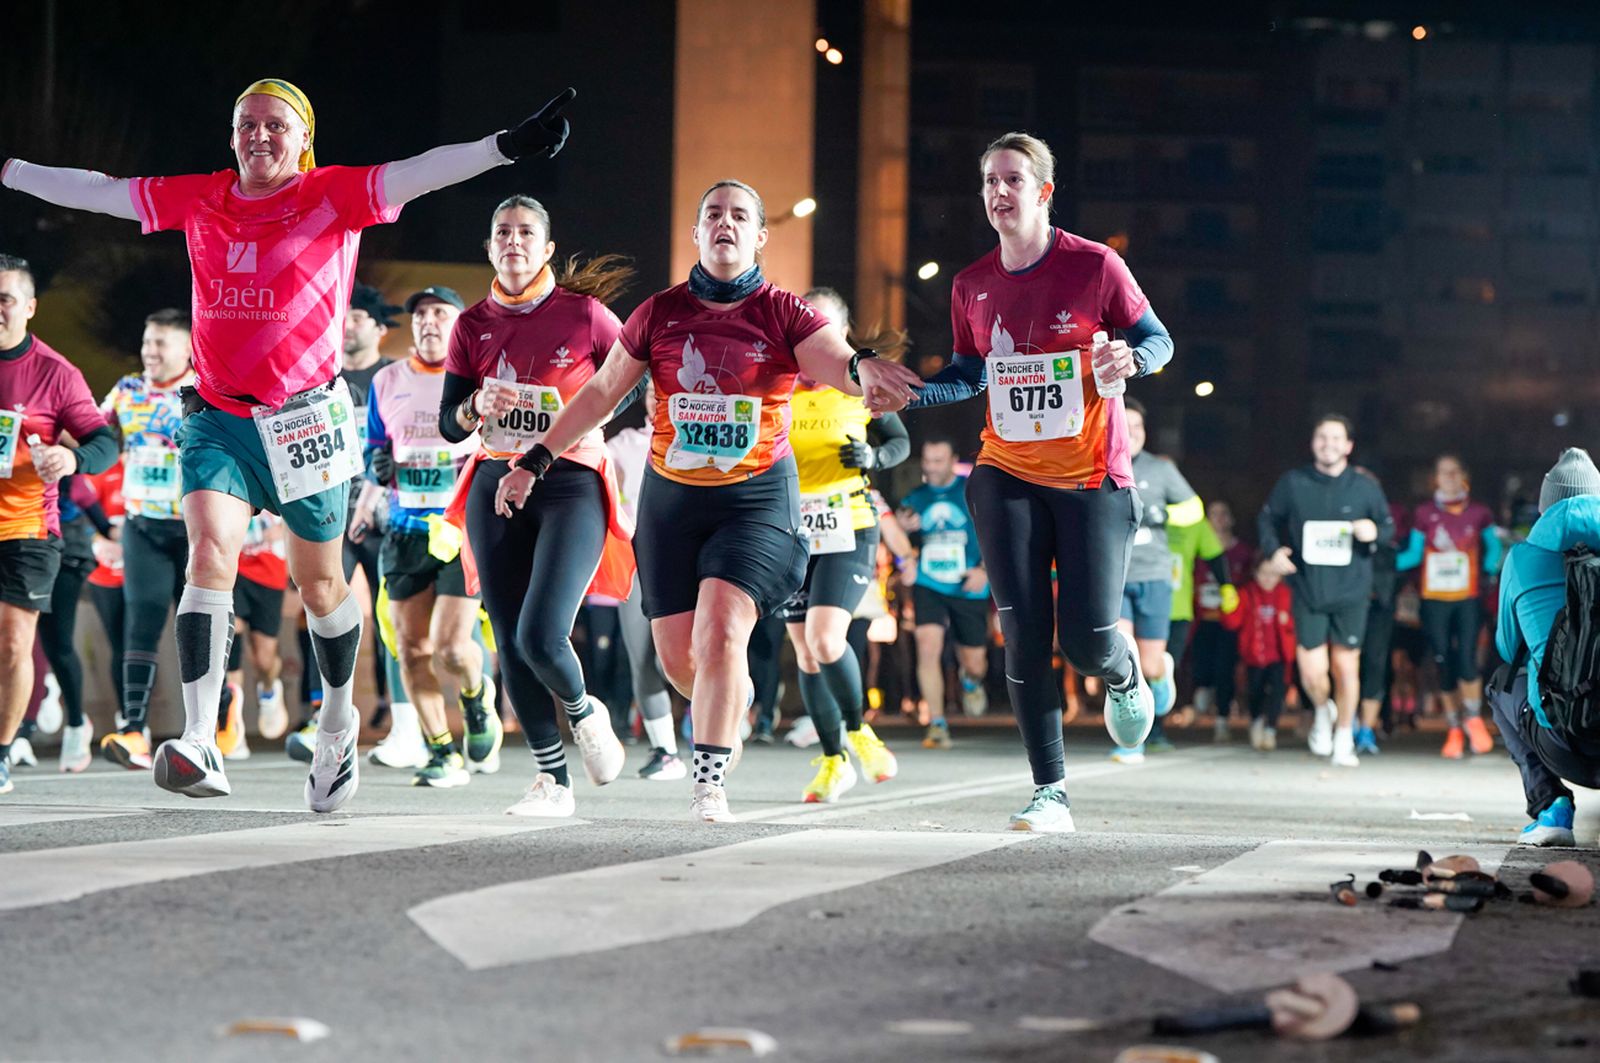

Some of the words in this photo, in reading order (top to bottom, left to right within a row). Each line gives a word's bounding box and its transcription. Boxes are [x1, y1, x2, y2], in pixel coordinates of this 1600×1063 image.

[208, 279, 275, 308] Jaén
[199, 307, 236, 320] PARAÍSO
[238, 310, 288, 322] INTERIOR
[1007, 364, 1032, 374] NOCHE
[1034, 363, 1045, 372] DE
[998, 375, 1014, 386] SAN
[1016, 372, 1046, 384] ANTÓN
[1009, 383, 1063, 412] 6773
[689, 402, 715, 412] NOCHE
[284, 415, 312, 431] NOCHE
[678, 411, 697, 421] SAN
[276, 431, 296, 446] SAN
[681, 422, 749, 449] 12838
[287, 427, 345, 469] 3334
[406, 468, 442, 486] 1072
